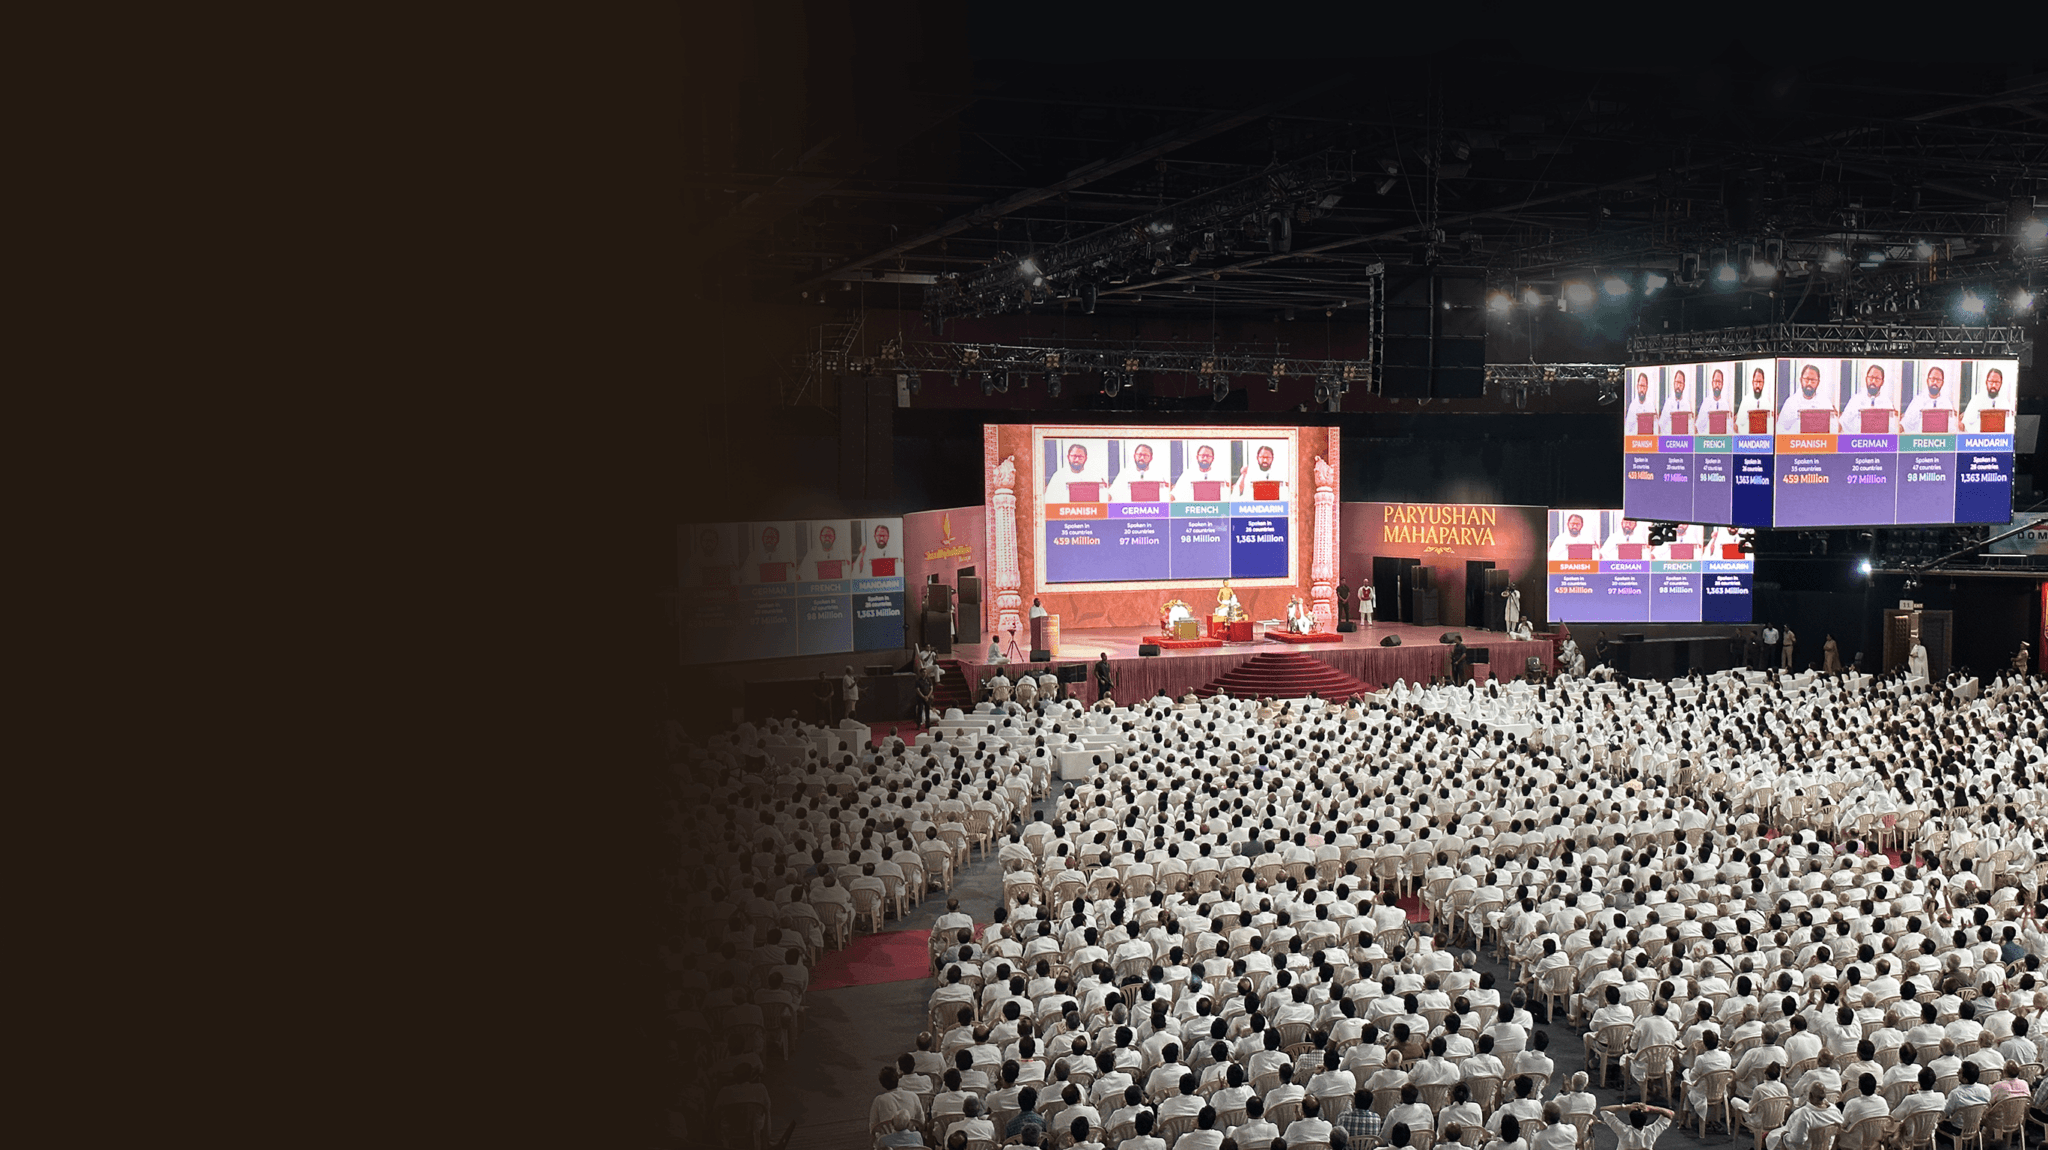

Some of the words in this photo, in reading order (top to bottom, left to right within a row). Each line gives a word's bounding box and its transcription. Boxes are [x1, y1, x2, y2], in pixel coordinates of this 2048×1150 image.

[1666, 440, 1688, 448] GERMAN
[1703, 440, 1725, 448] FRENCH
[1738, 440, 1770, 448] MANDARIN
[1790, 440, 1827, 448] SPANISH
[1913, 439, 1946, 447] FRENCH
[1966, 439, 2008, 447] MANDARIN
[1638, 470, 1654, 480] Million
[1671, 473, 1688, 482] Million
[1708, 472, 1725, 482] Million
[1783, 474, 1799, 483] 459
[1800, 474, 1829, 483] Million
[1859, 475, 1887, 483] Million
[1919, 473, 1946, 481] Million
[1961, 474, 1980, 483] 1,363
[1981, 473, 2007, 481] Million
[1750, 475, 1769, 484] Million
[1060, 507, 1097, 515] SPANISH
[1384, 506, 1496, 526] PARYUSHAN
[1384, 525, 1496, 545] MAHAPARVA
[1072, 537, 1100, 545] Million
[860, 581, 899, 589] MANDARIN
[752, 587, 786, 595] GERMAN
[761, 617, 787, 625] Million
